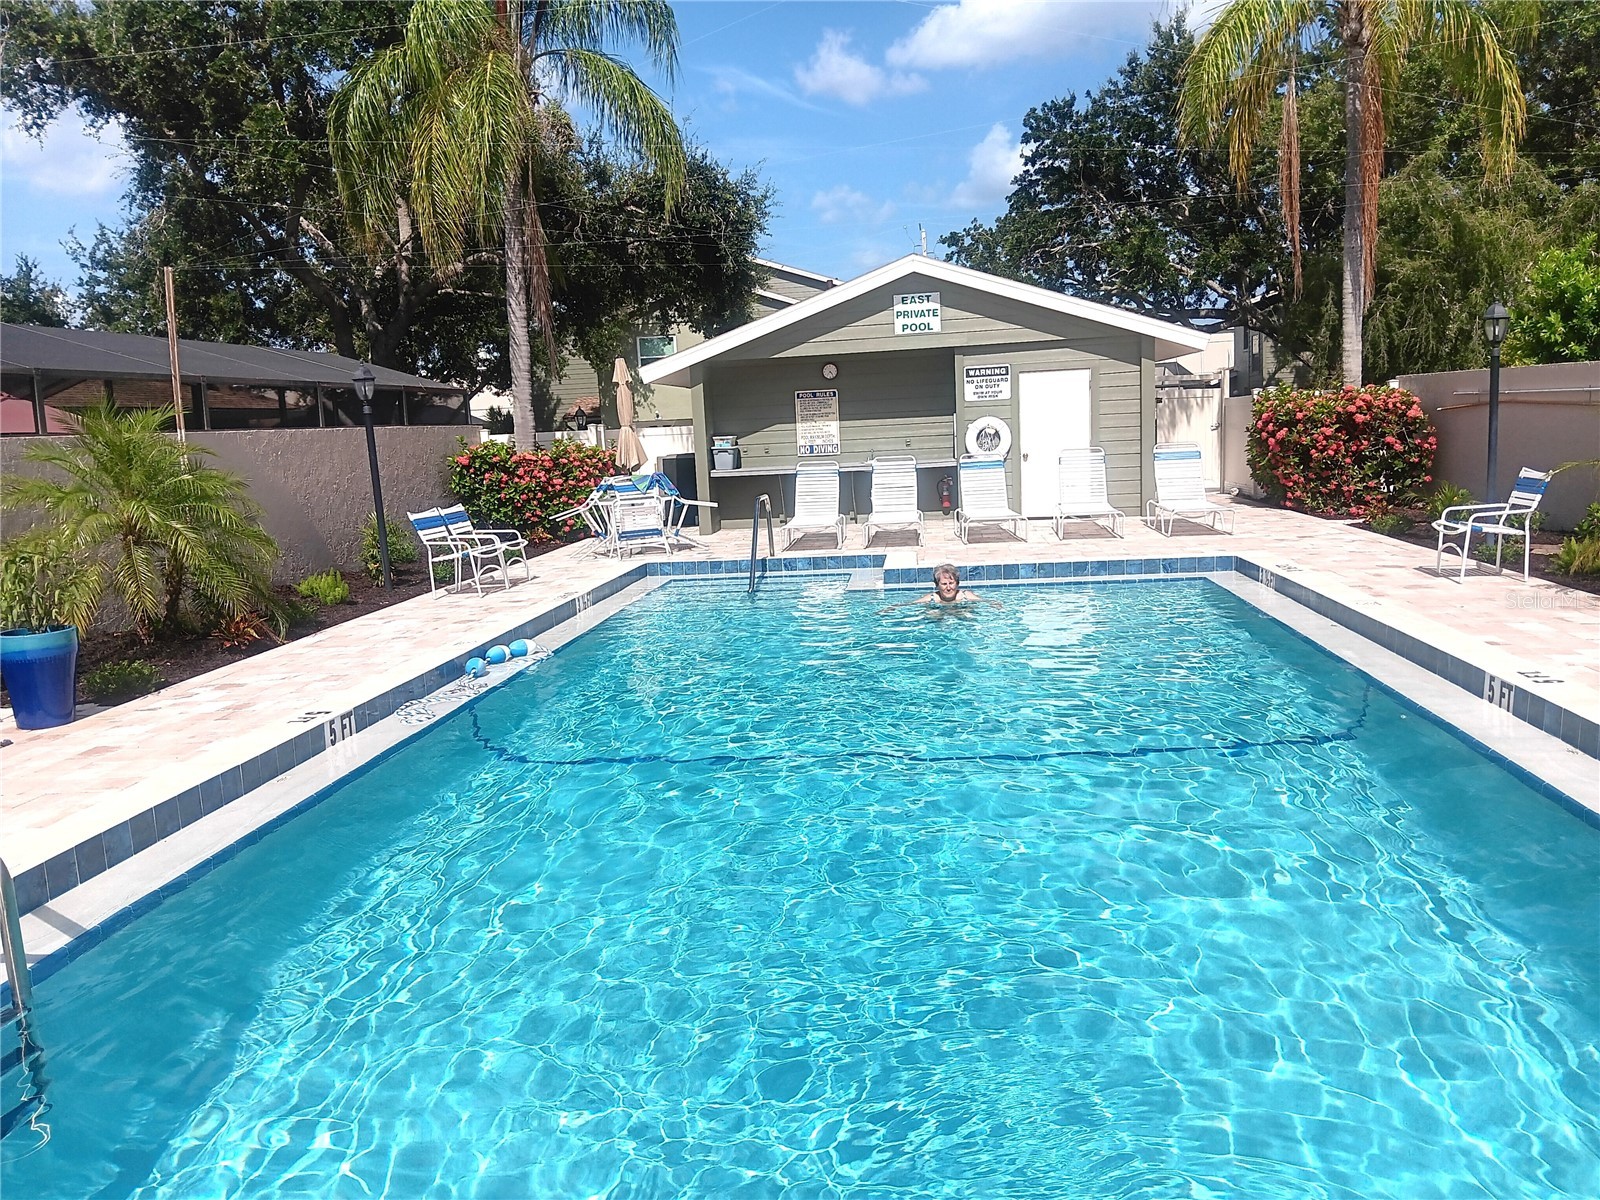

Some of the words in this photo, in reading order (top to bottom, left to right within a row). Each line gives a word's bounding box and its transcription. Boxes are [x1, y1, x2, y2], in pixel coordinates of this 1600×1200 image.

[901, 294, 932, 305] EAST
[896, 308, 939, 319] PRIVATE
[902, 322, 934, 332] POOL
[968, 367, 1006, 376] WARNING
[800, 445, 811, 454] NO
[813, 444, 838, 454] DIVING
[1488, 675, 1495, 703] 5
[1499, 680, 1513, 712] FT
[329, 720, 337, 746] 5
[340, 711, 353, 740] FT
